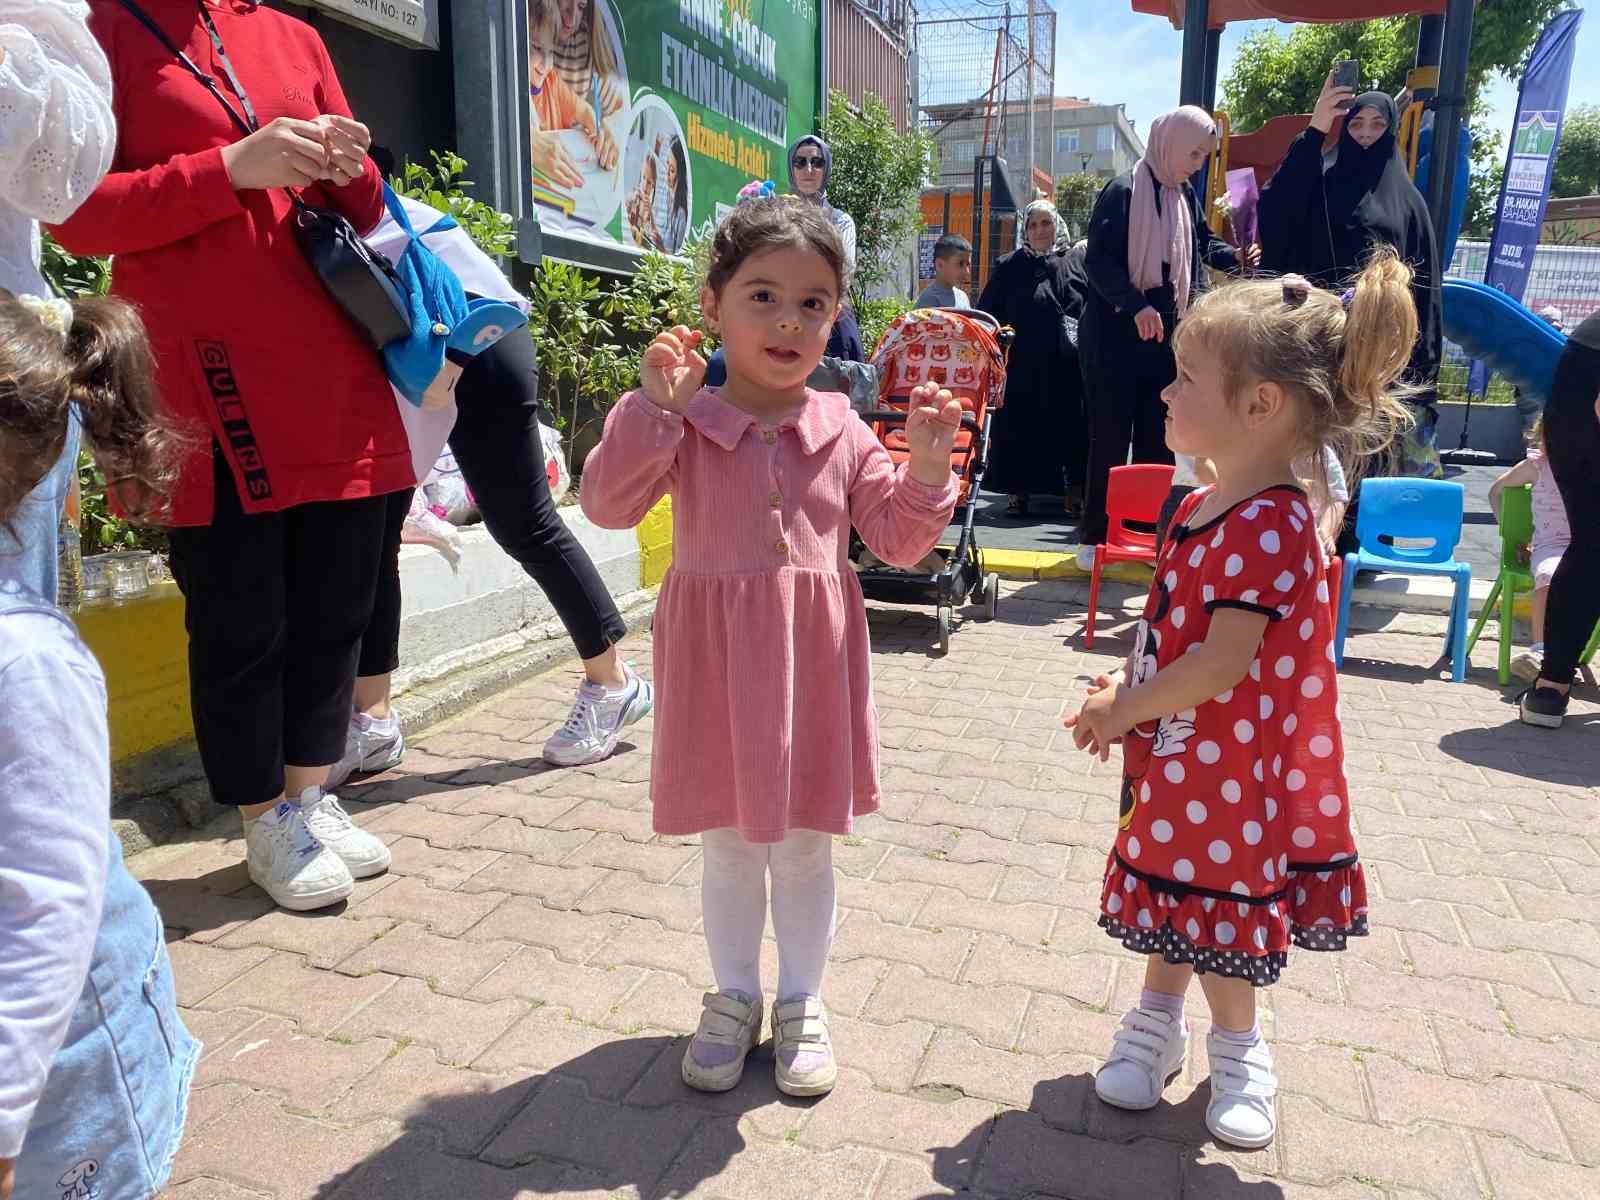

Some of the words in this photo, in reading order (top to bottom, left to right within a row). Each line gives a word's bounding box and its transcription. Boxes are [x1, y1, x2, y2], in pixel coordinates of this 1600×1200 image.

[381, 3, 399, 20] NO:
[402, 11, 418, 26] 127
[732, 11, 777, 83] ÇOCUK
[661, 31, 733, 121] ETKİNLİK
[735, 76, 787, 148] MERKEZİ
[687, 112, 736, 167] Hizmete
[737, 136, 765, 180] Açıldı
[1516, 197, 1540, 210] HAKAN
[202, 342, 270, 498] GULINS
